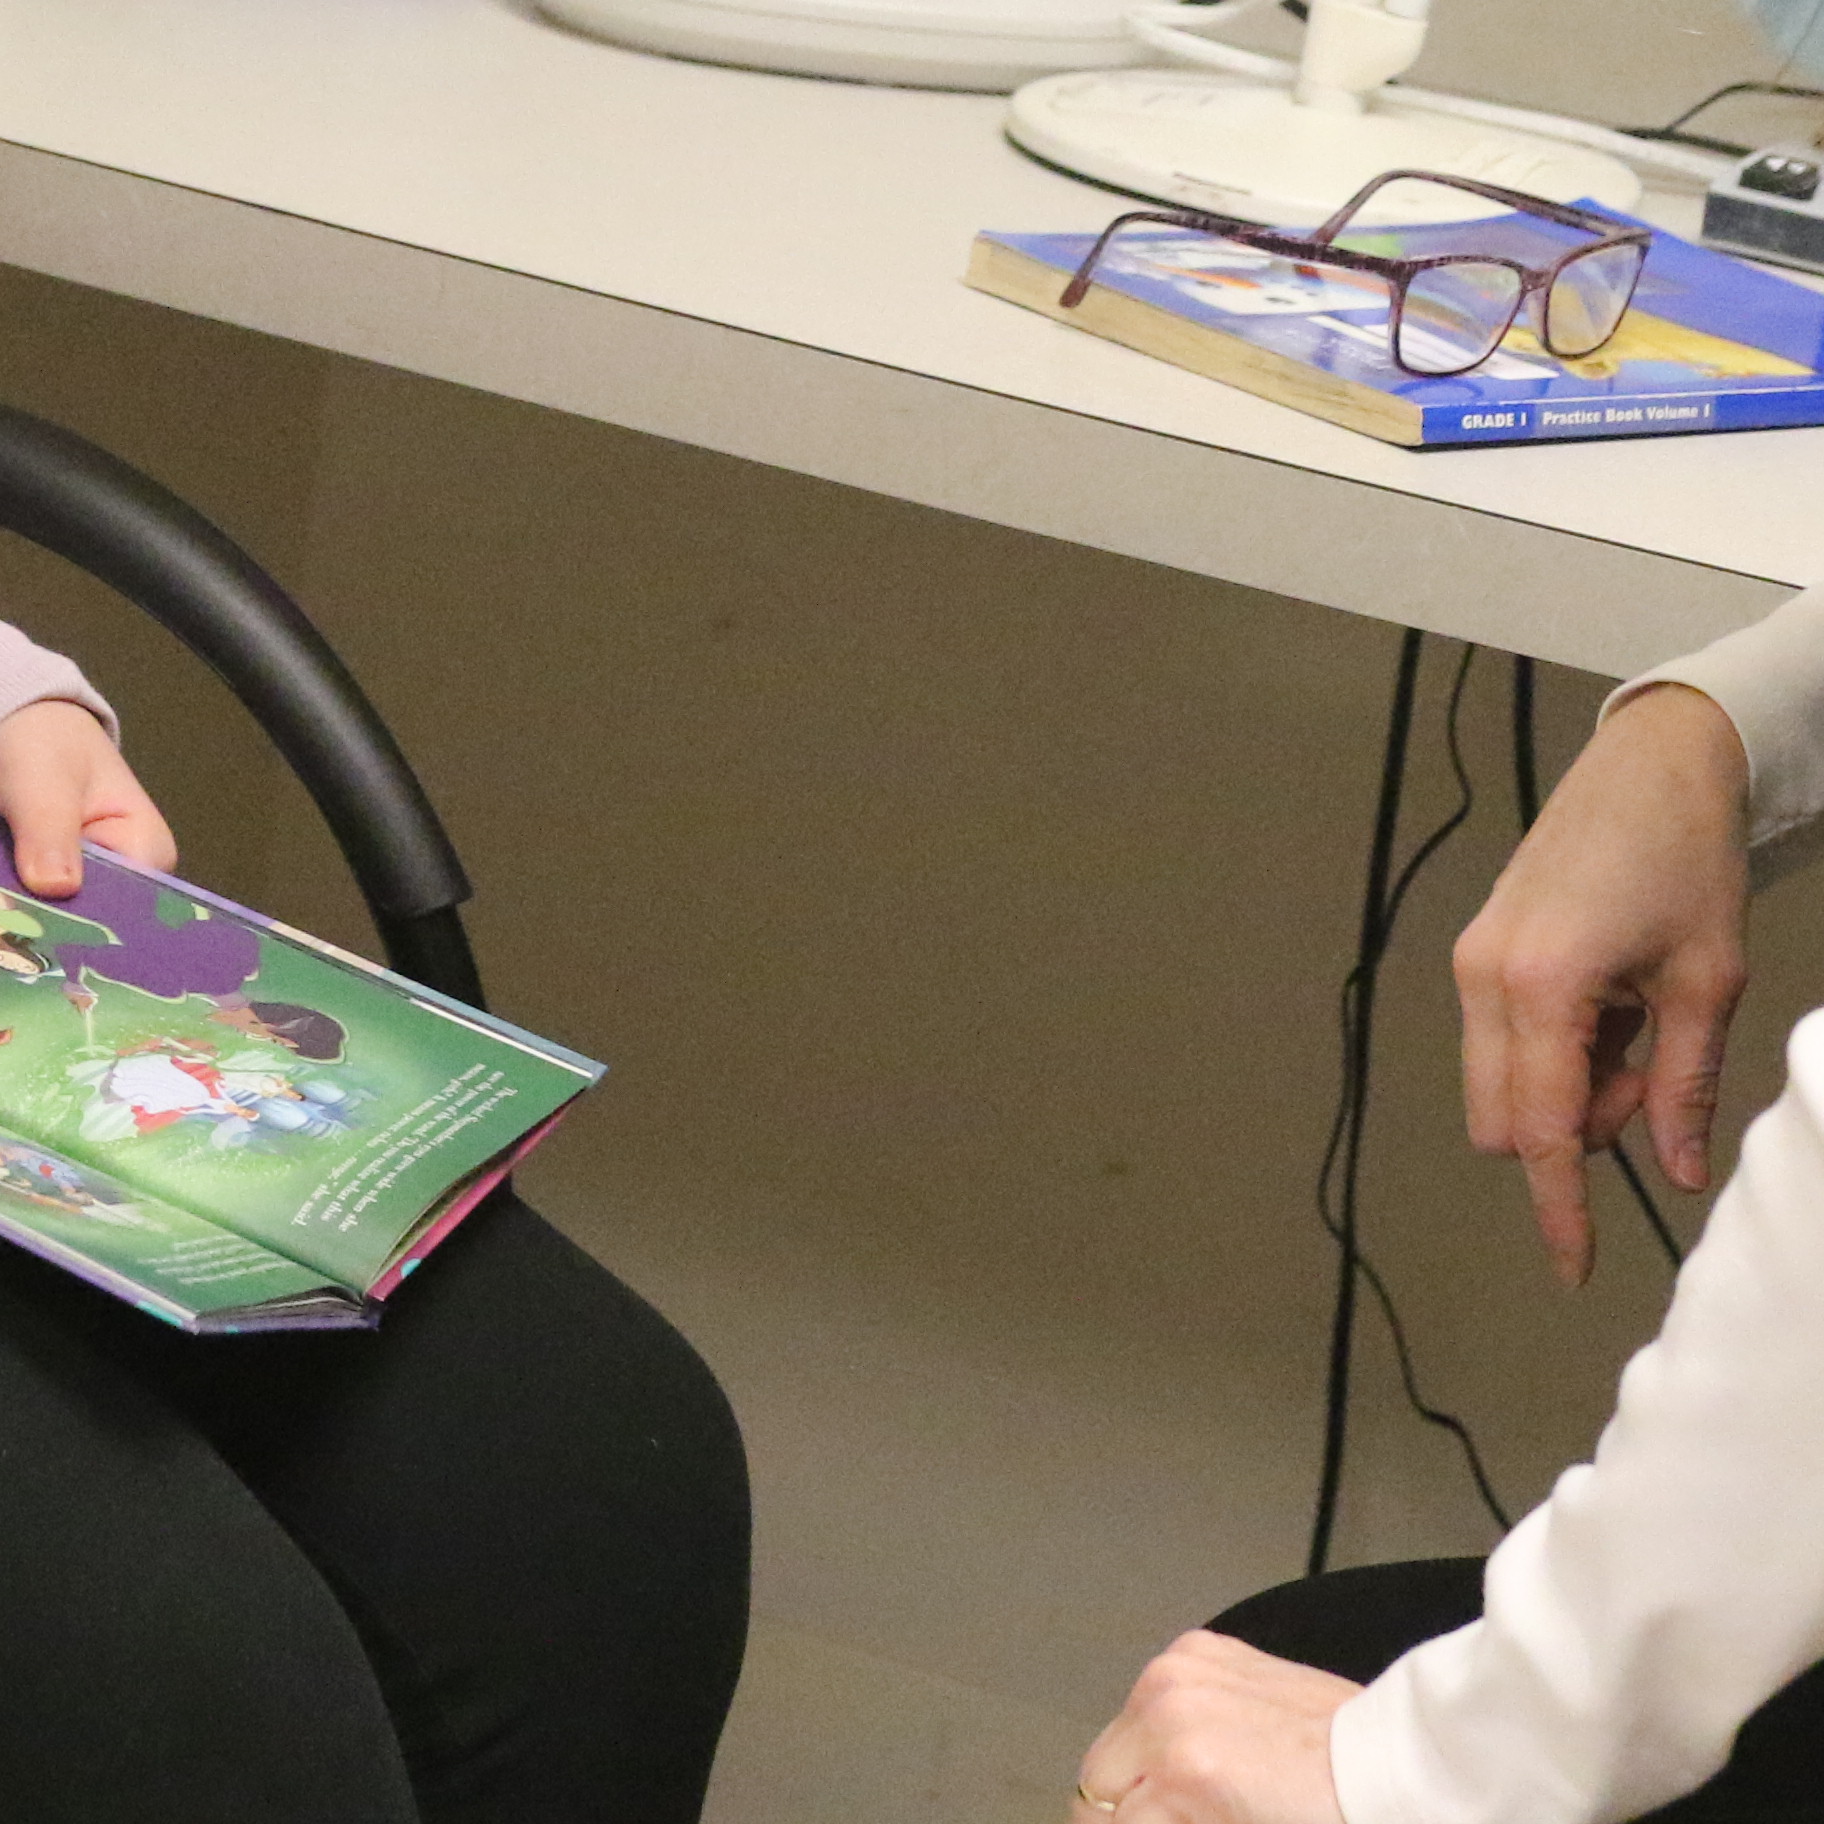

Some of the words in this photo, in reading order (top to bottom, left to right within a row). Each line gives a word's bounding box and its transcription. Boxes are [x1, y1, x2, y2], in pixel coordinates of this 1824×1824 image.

[1461, 412, 1515, 430] GRADE
[1542, 409, 1602, 426] Practice
[1606, 407, 1643, 423] Book
[1647, 404, 1699, 420] Volume
